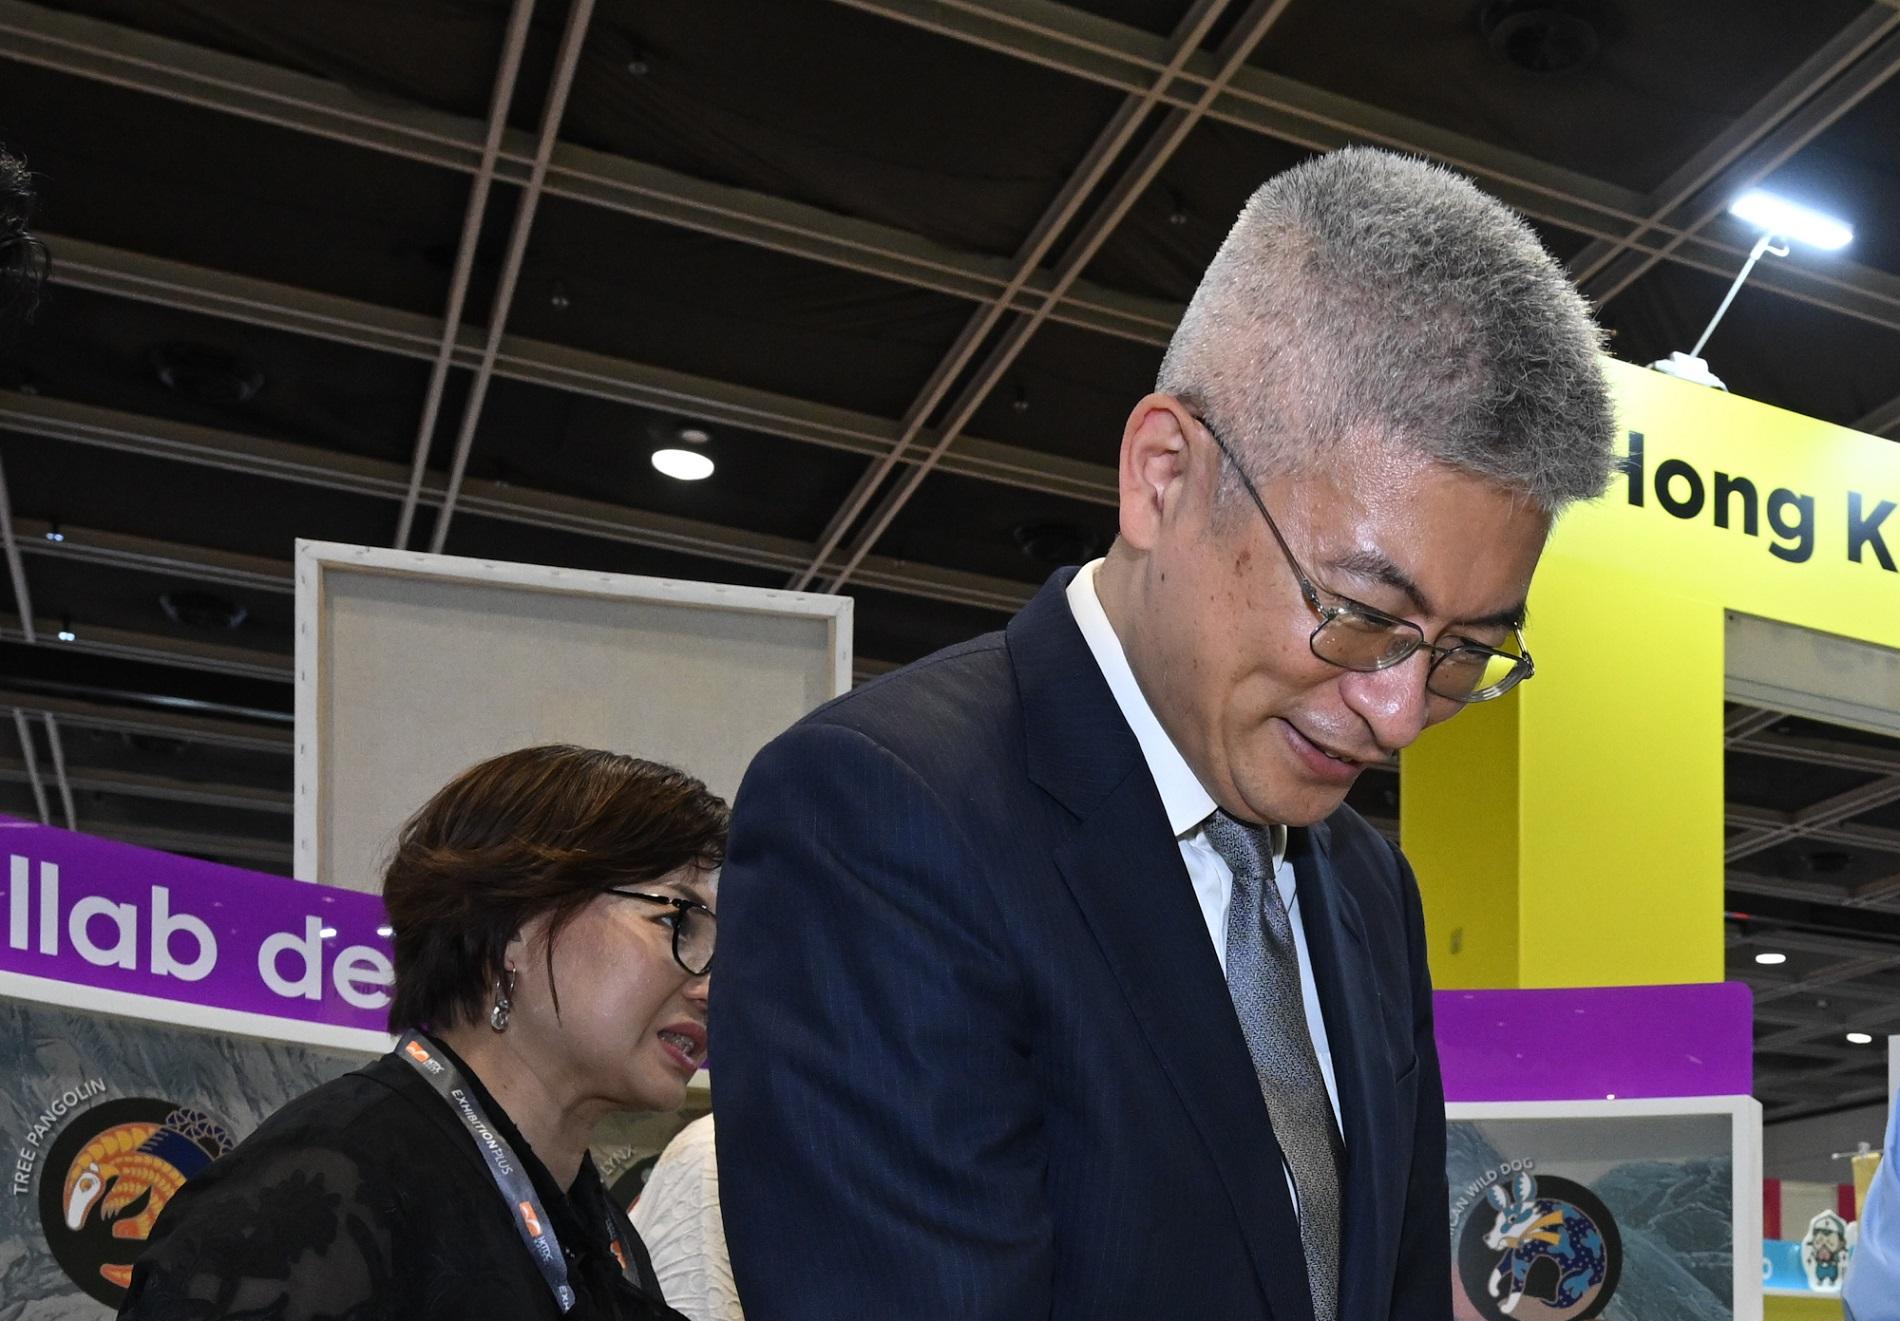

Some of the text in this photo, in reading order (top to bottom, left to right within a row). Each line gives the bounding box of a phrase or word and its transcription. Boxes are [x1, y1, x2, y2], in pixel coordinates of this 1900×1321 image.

[9, 854, 218, 982] llab
[13, 1077, 107, 1196] TREE PANGOLIN
[1465, 1169, 1498, 1198] WILD
[1499, 1158, 1534, 1176] DOG
